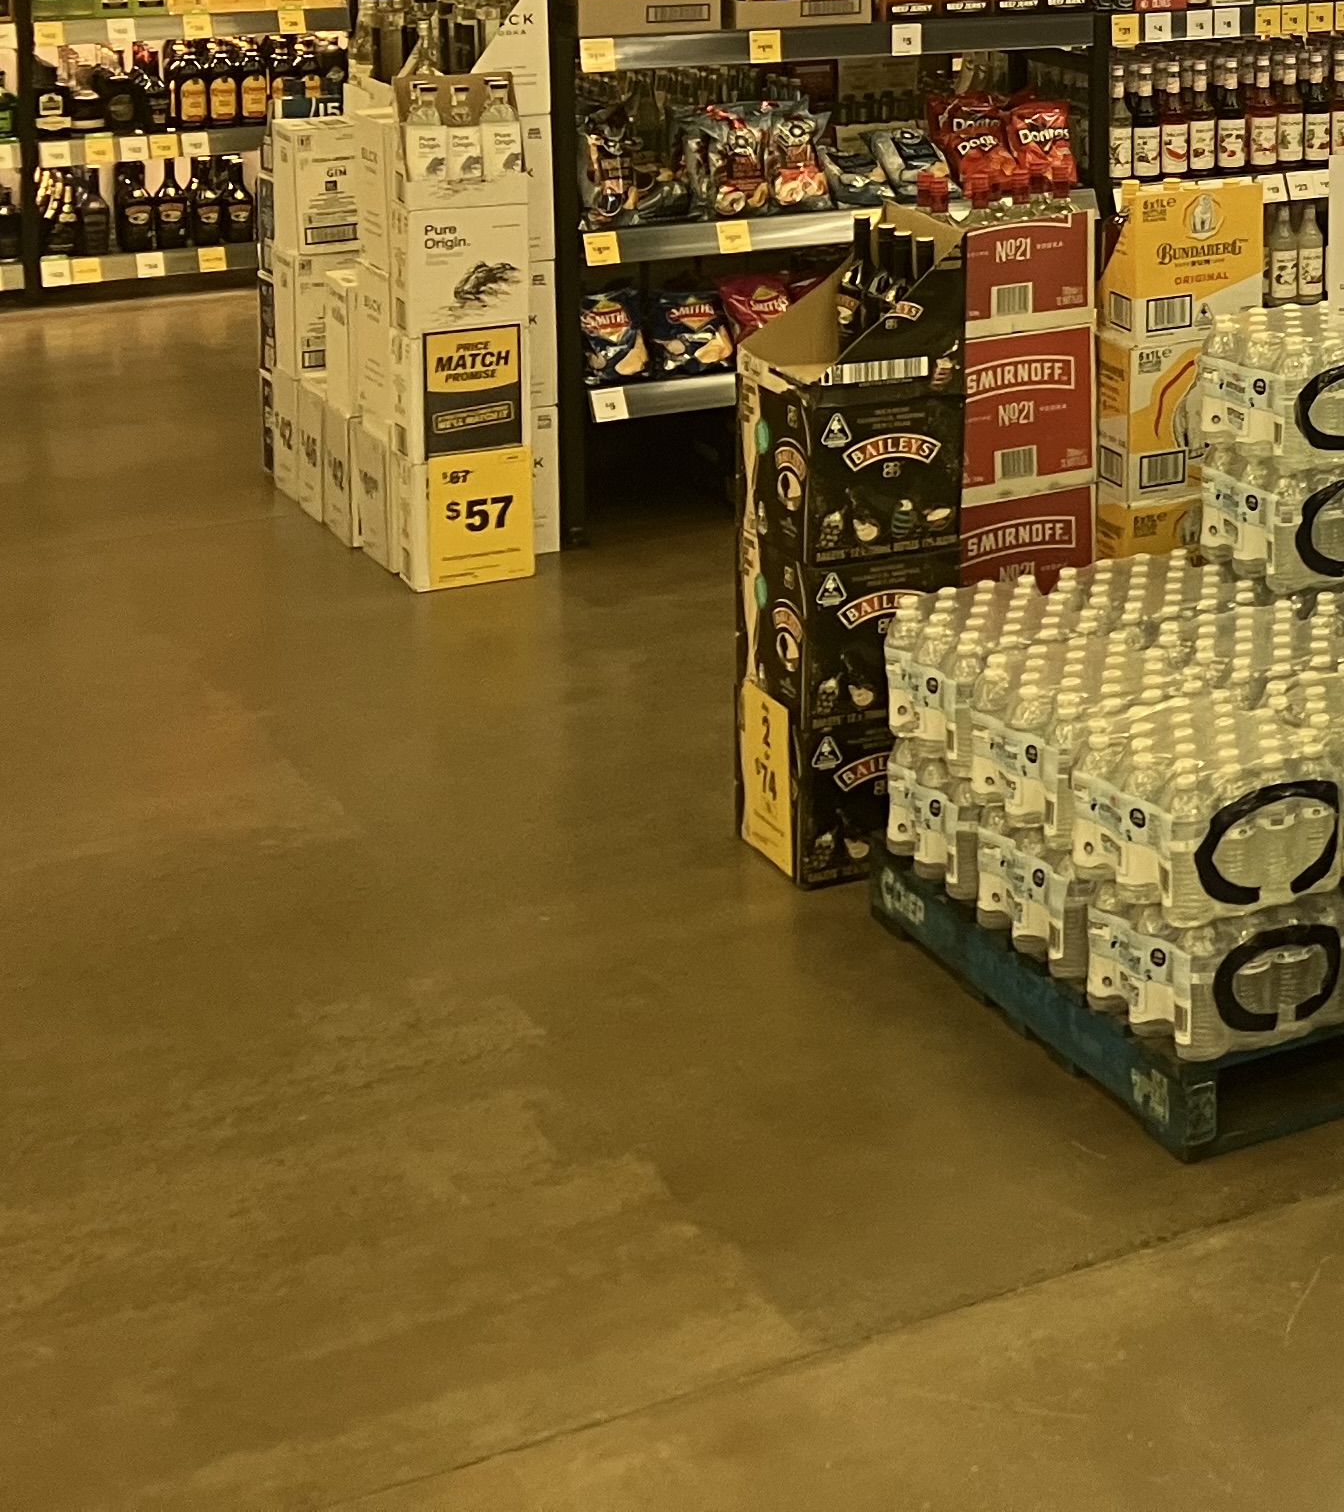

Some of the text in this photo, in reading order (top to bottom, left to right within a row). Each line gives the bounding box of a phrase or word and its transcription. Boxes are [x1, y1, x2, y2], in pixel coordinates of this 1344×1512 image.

[1019, 128, 1070, 145] Doritos
[326, 168, 347, 177] GIN
[424, 224, 457, 236] Pure
[424, 236, 471, 251] Origin.
[1174, 272, 1229, 286] ORIGINAL
[456, 340, 491, 353] PRICE
[435, 350, 510, 373] MATCH
[444, 368, 497, 383] PROMISE
[966, 362, 1064, 395] SMIRNOFF
[852, 437, 936, 465] BAILEYS
[446, 495, 514, 533] $57
[967, 522, 1065, 557] SMIRNOFF
